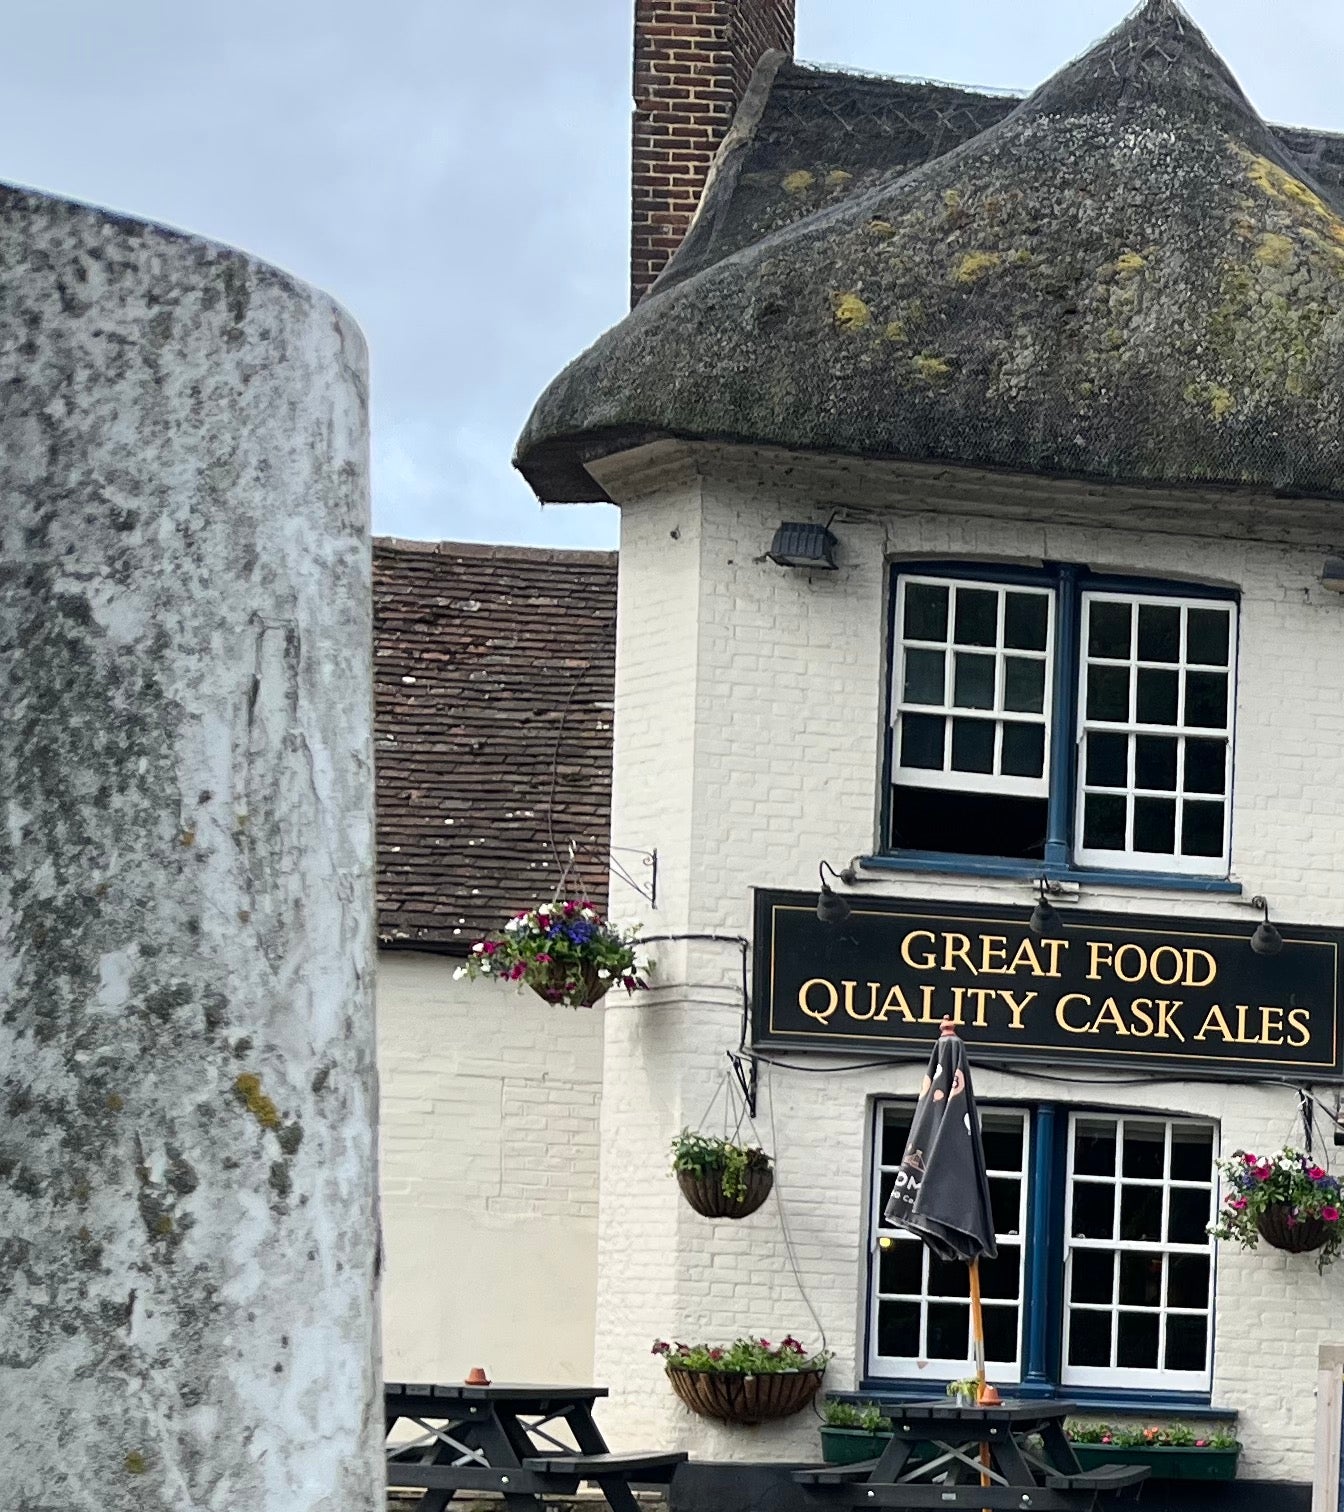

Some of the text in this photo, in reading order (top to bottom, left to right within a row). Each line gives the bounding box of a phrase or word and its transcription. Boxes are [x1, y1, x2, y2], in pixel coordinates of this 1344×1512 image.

[900, 930, 1217, 987] GREAT FOOD
[798, 978, 1310, 1046] QUALITY CASK ALES
